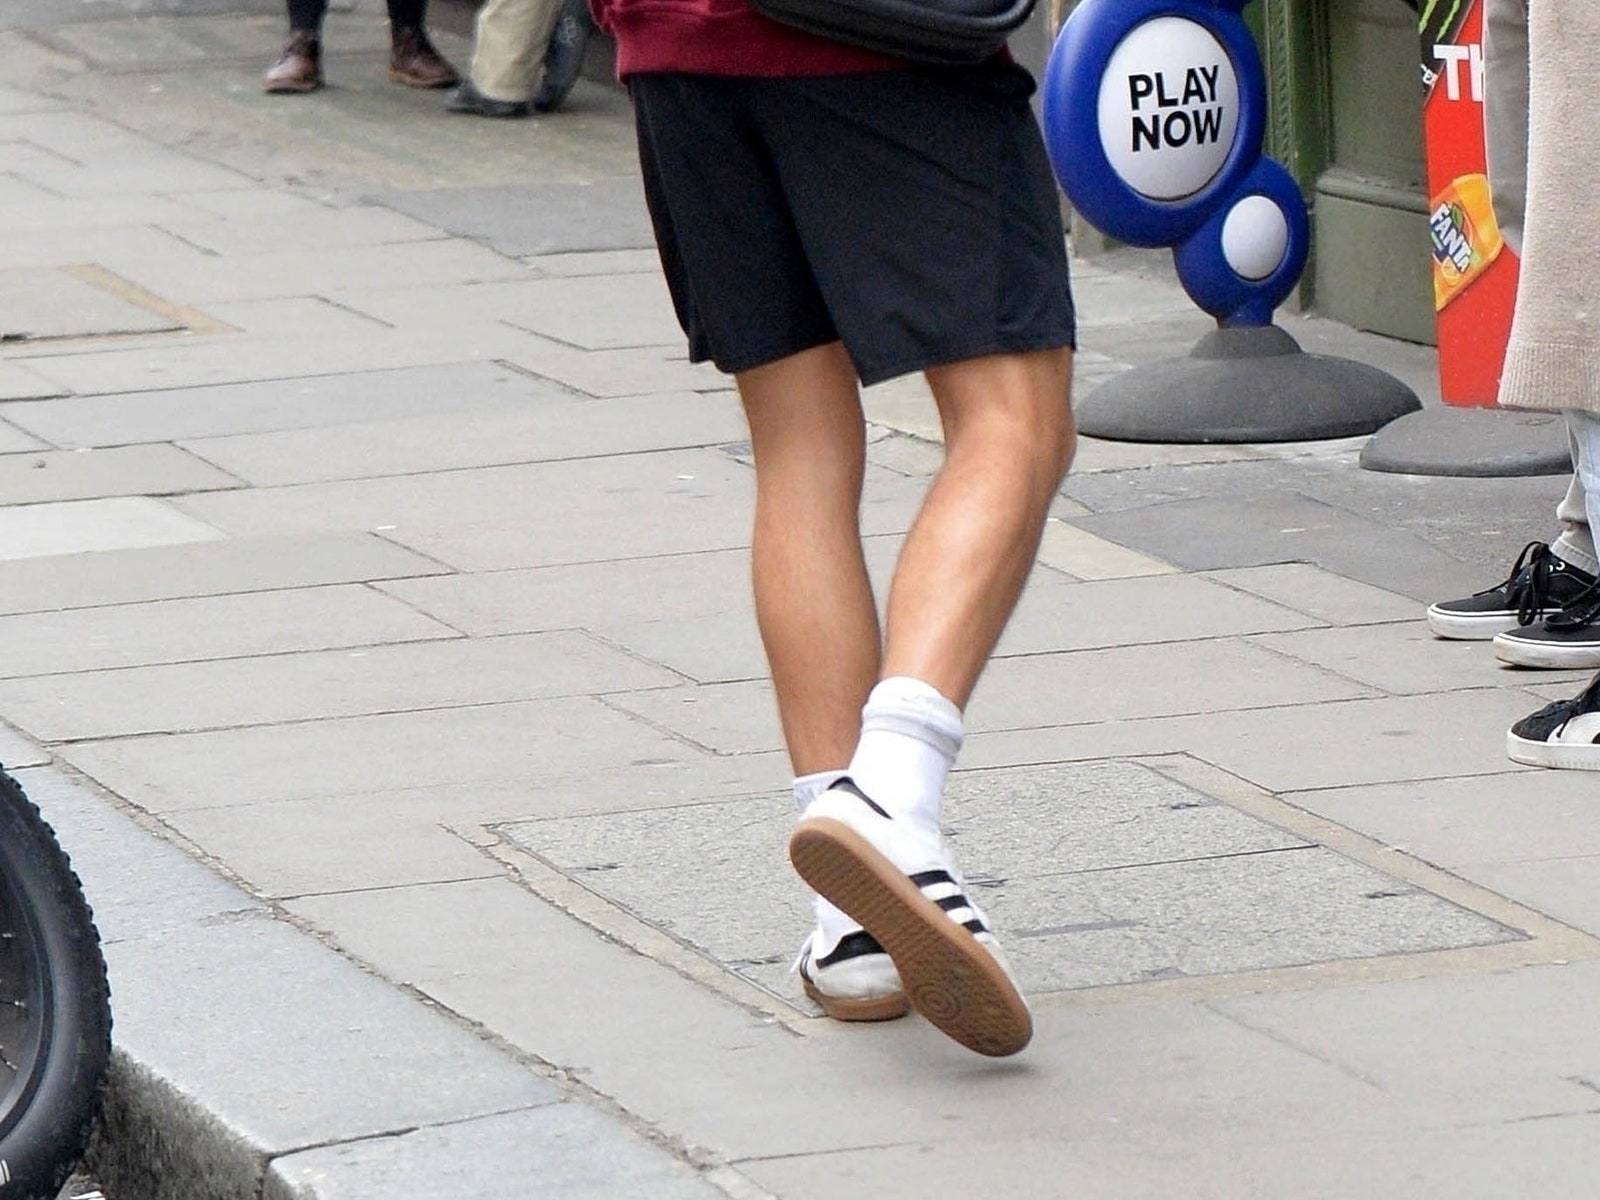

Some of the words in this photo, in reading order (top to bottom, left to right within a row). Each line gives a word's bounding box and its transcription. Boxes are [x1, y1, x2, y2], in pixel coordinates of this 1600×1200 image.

[1128, 65, 1219, 111] PLAY
[1132, 106, 1223, 152] NOW
[1430, 202, 1472, 273] FANTA
